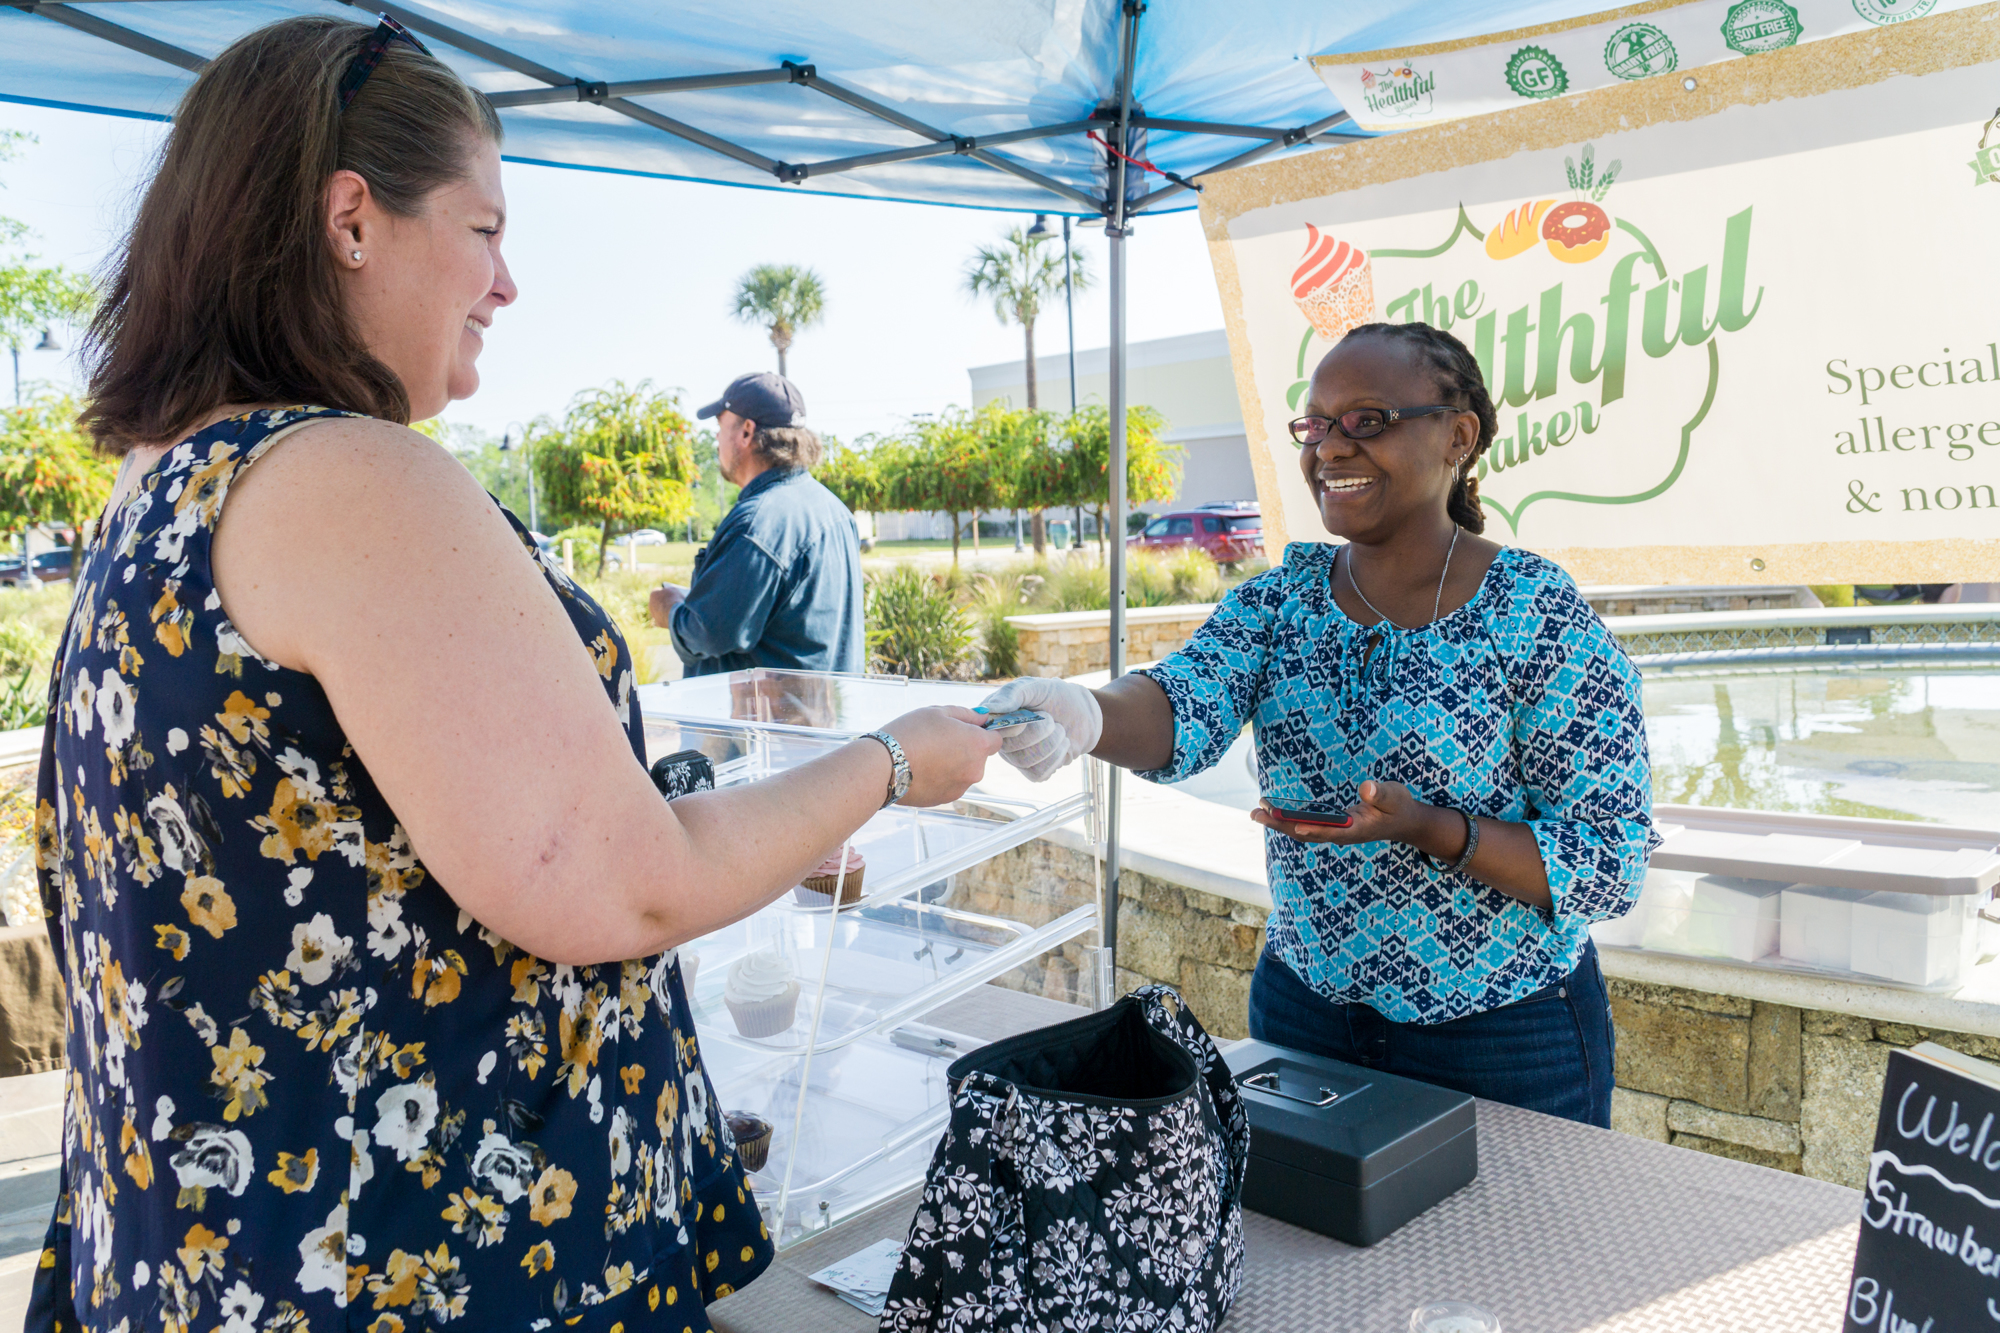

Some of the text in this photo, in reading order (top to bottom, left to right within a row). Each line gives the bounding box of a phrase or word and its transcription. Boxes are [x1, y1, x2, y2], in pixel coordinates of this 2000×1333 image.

[1737, 5, 1776, 22] SOY FREE
[1878, 10, 1918, 23] PEANUT
[1734, 18, 1790, 41] SOY FREE
[1511, 52, 1556, 76] GLUTEN FREE
[1613, 37, 1669, 75] DAIRY FREE
[1364, 70, 1437, 112] Healthful
[1378, 80, 1394, 93] The
[1520, 67, 1549, 88] GF
[1386, 279, 1485, 331] The
[1825, 342, 2000, 406] Special
[1834, 416, 2000, 461] allerge
[1845, 479, 2000, 514] & non
